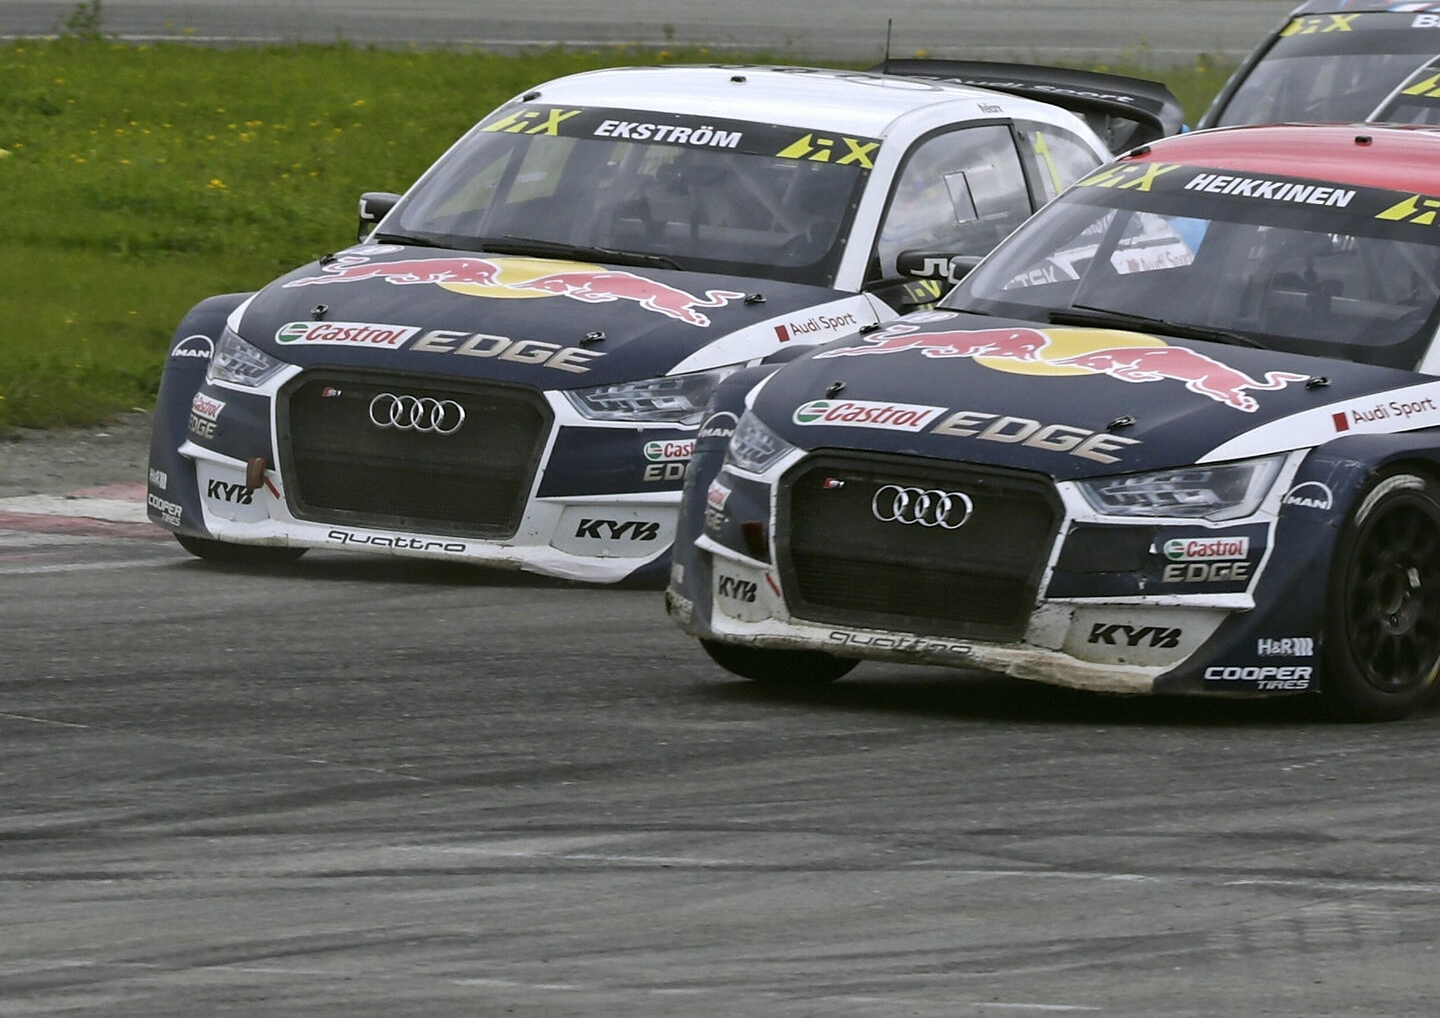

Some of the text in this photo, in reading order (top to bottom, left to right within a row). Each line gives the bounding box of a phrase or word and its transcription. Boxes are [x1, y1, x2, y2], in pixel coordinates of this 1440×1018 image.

[593, 119, 743, 149] EKSTRÖM
[1184, 173, 1357, 208] HEIKKINEN
[790, 312, 857, 335] Audi Sport
[305, 323, 608, 374] Castrol EDGE
[1351, 397, 1437, 424] Audi Sport
[824, 402, 1141, 465] Castrol EDGE
[148, 493, 182, 518] COOPER
[328, 529, 466, 553] quattro
[575, 518, 661, 541] KYB
[1186, 538, 1244, 558] Castrol
[1163, 562, 1251, 583] EDGE
[829, 631, 973, 655] quattro
[1088, 622, 1183, 649] KYB
[1257, 637, 1293, 655] H&R
[1204, 666, 1313, 680] COOPER
[1257, 679, 1311, 690] TIRES
